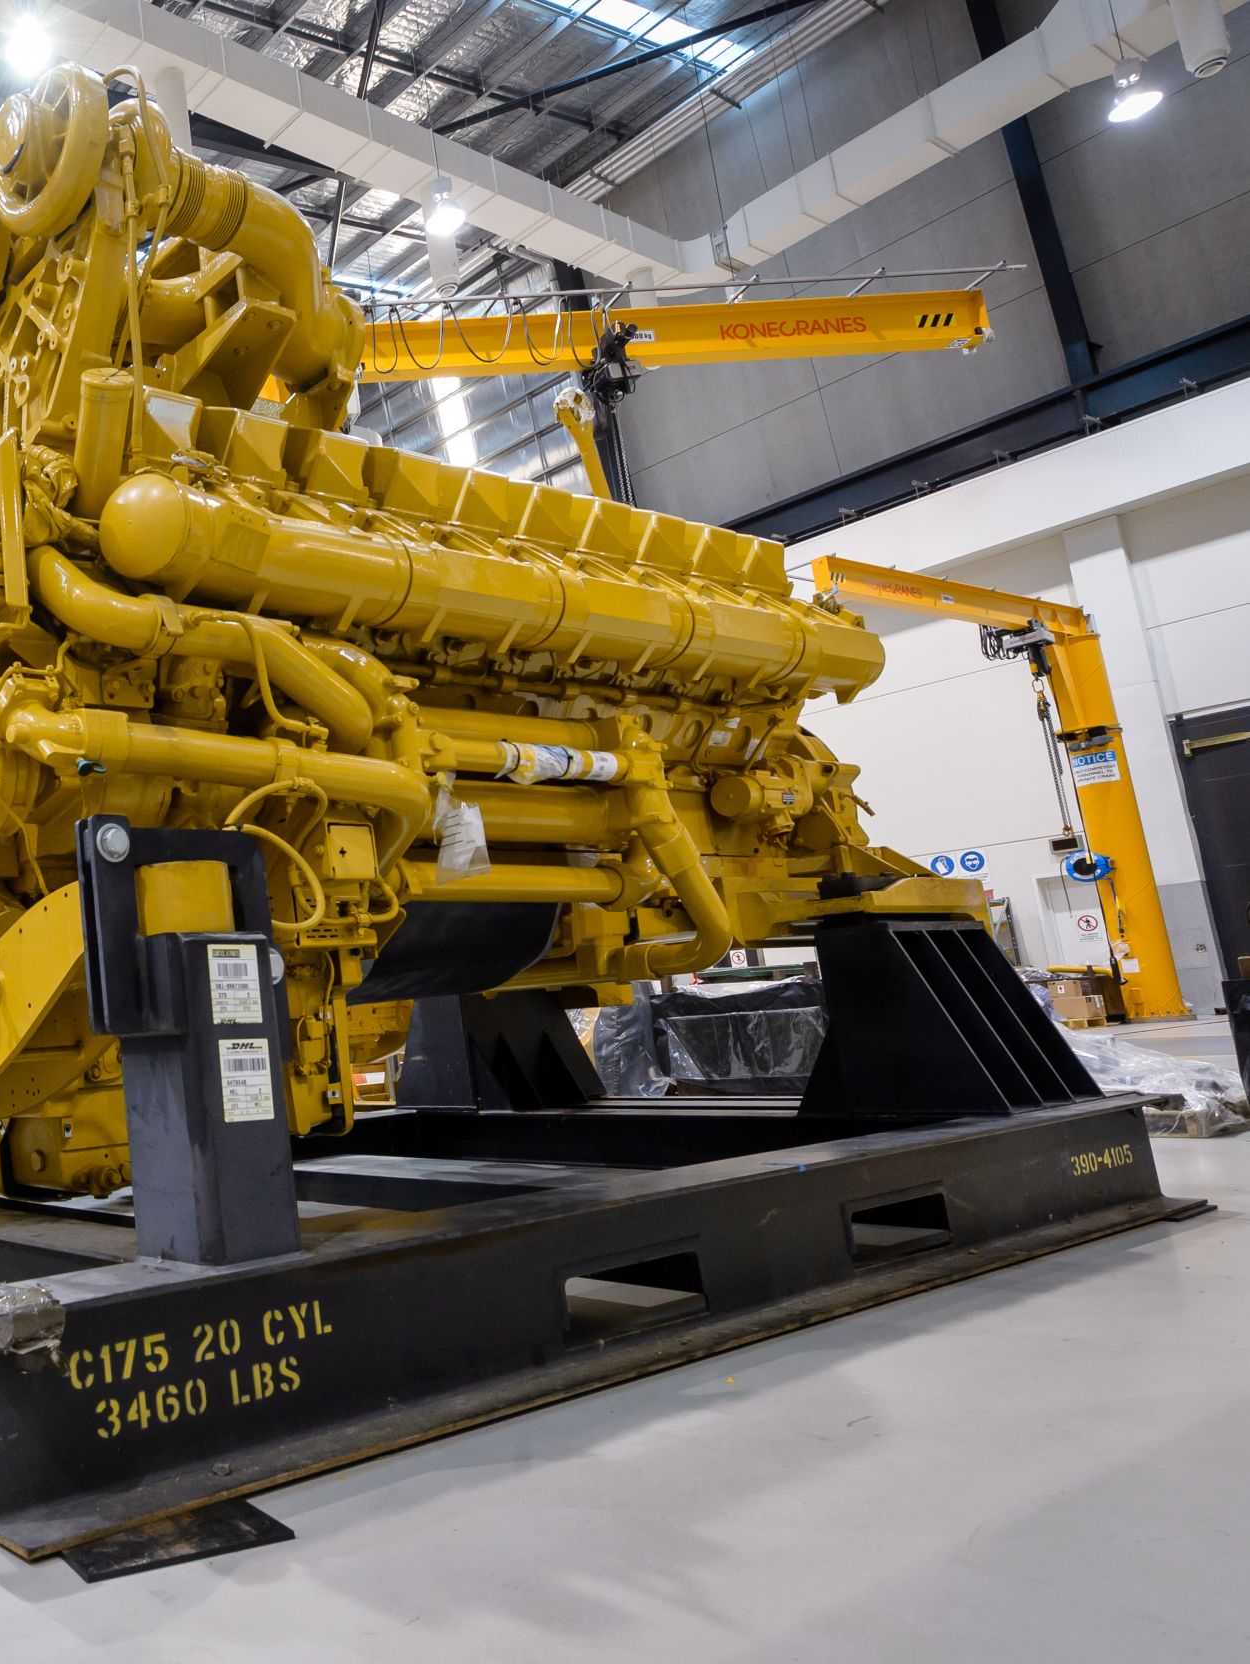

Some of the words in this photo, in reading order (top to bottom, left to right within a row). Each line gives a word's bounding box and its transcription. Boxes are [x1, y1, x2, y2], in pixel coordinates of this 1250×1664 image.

[719, 316, 867, 341] KONECRANES
[230, 1042, 256, 1050] DHL
[1070, 1144, 1133, 1176] 390-4105
[69, 1332, 170, 1390] C175
[193, 1318, 242, 1363] 20
[262, 1300, 333, 1346] CYL
[95, 1377, 207, 1439] 3460
[230, 1355, 301, 1406] LBS
